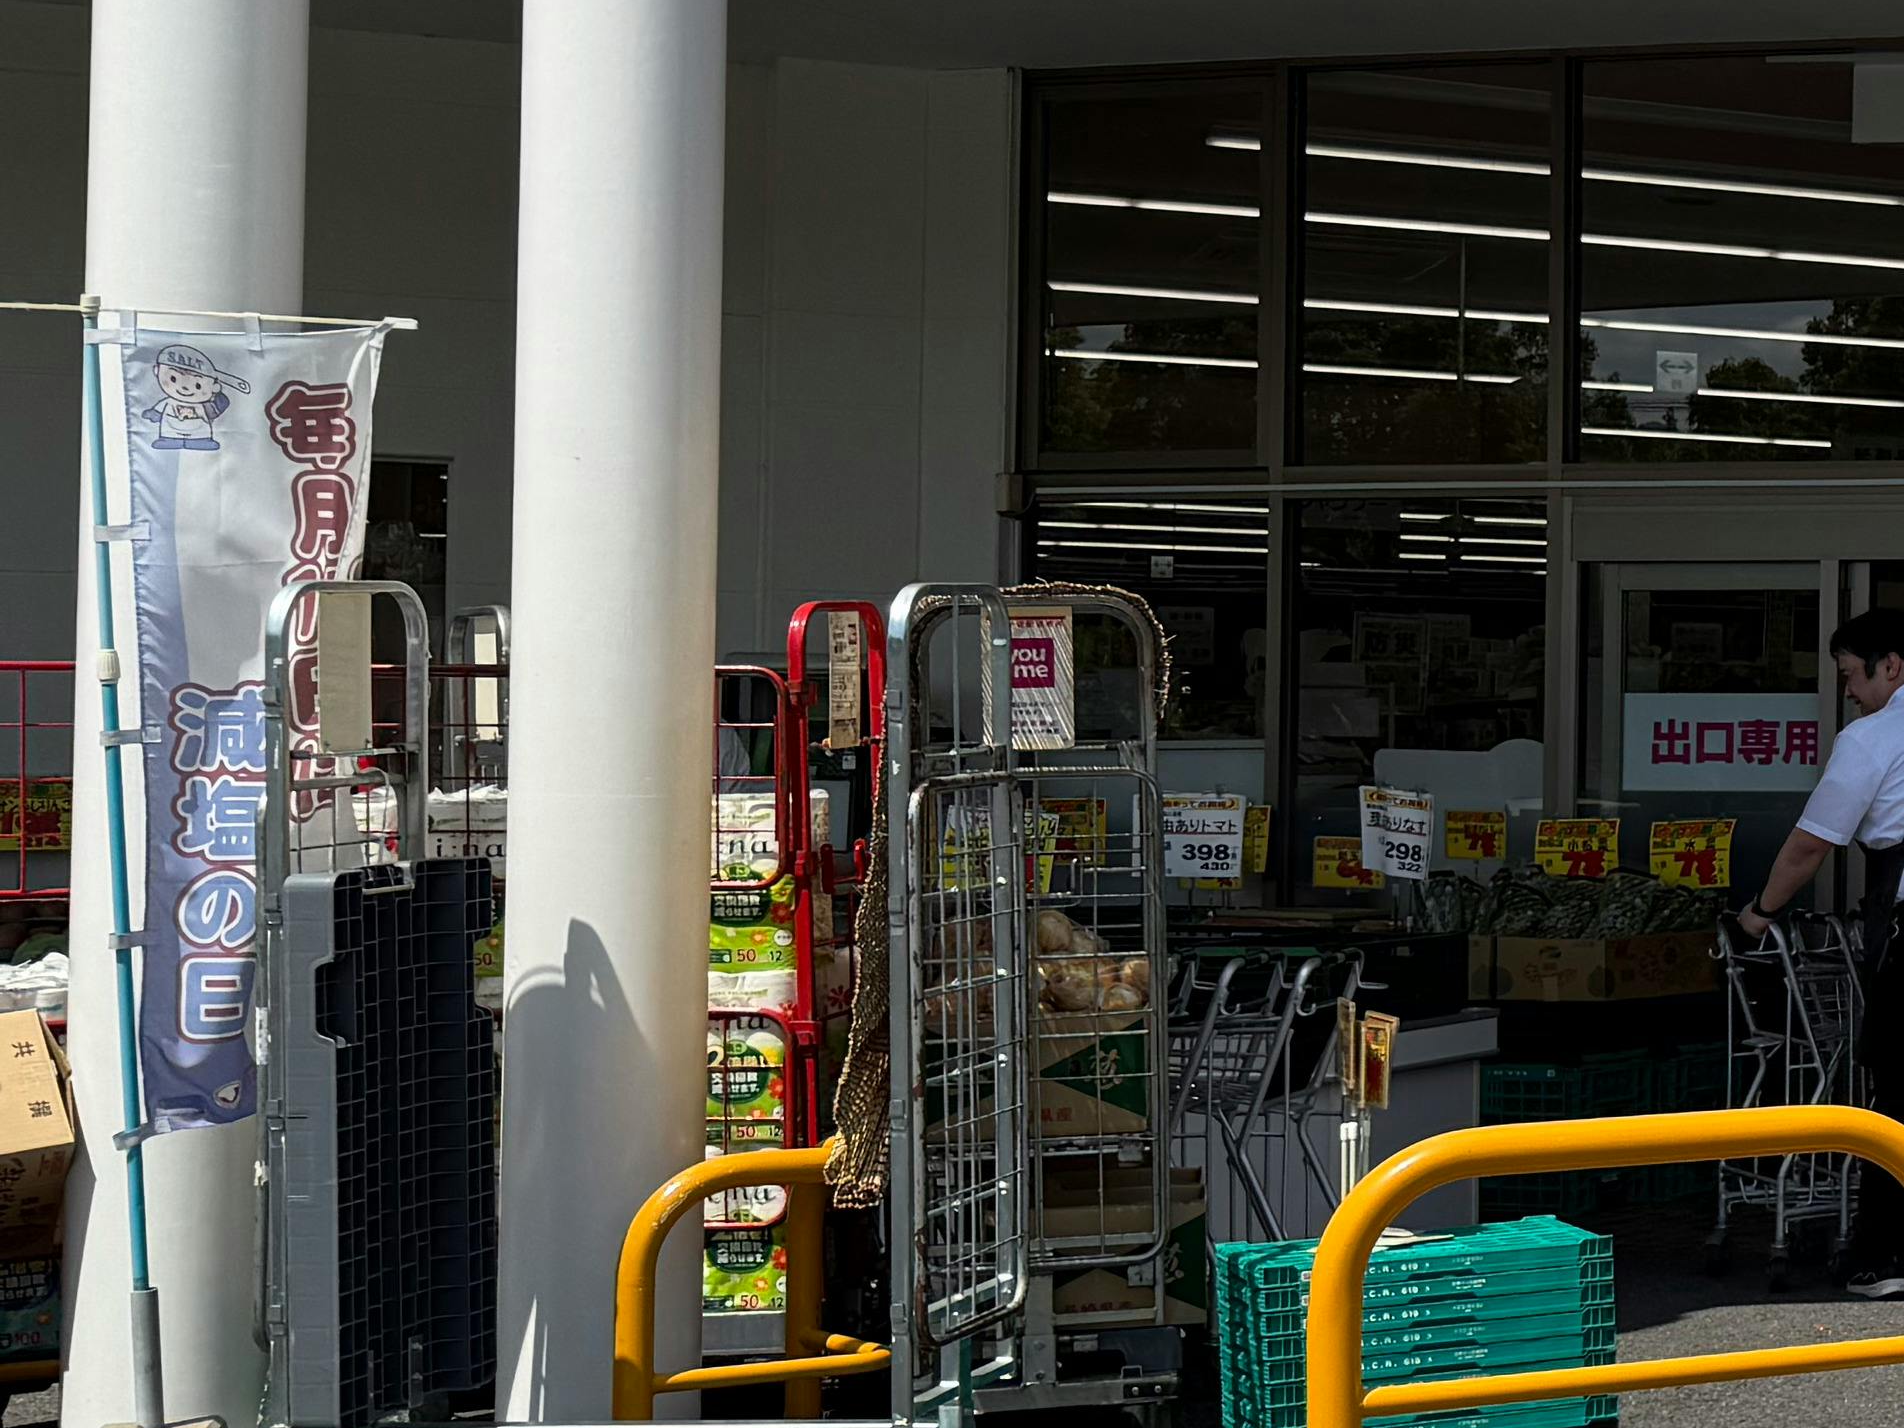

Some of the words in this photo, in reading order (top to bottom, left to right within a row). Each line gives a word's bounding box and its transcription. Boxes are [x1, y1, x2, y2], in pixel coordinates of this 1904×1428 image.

[167, 351, 204, 370] SALT
[1014, 665, 1048, 678] me
[1652, 720, 1818, 765] 出口専用
[1182, 843, 1230, 861] 398
[1385, 841, 1422, 862] 298
[174, 682, 266, 1042] 減塩の日
[1200, 862, 1230, 870] 430
[1398, 861, 1423, 872] 322
[737, 949, 756, 962] 50
[769, 949, 783, 962] 12
[736, 1125, 756, 1139] 50
